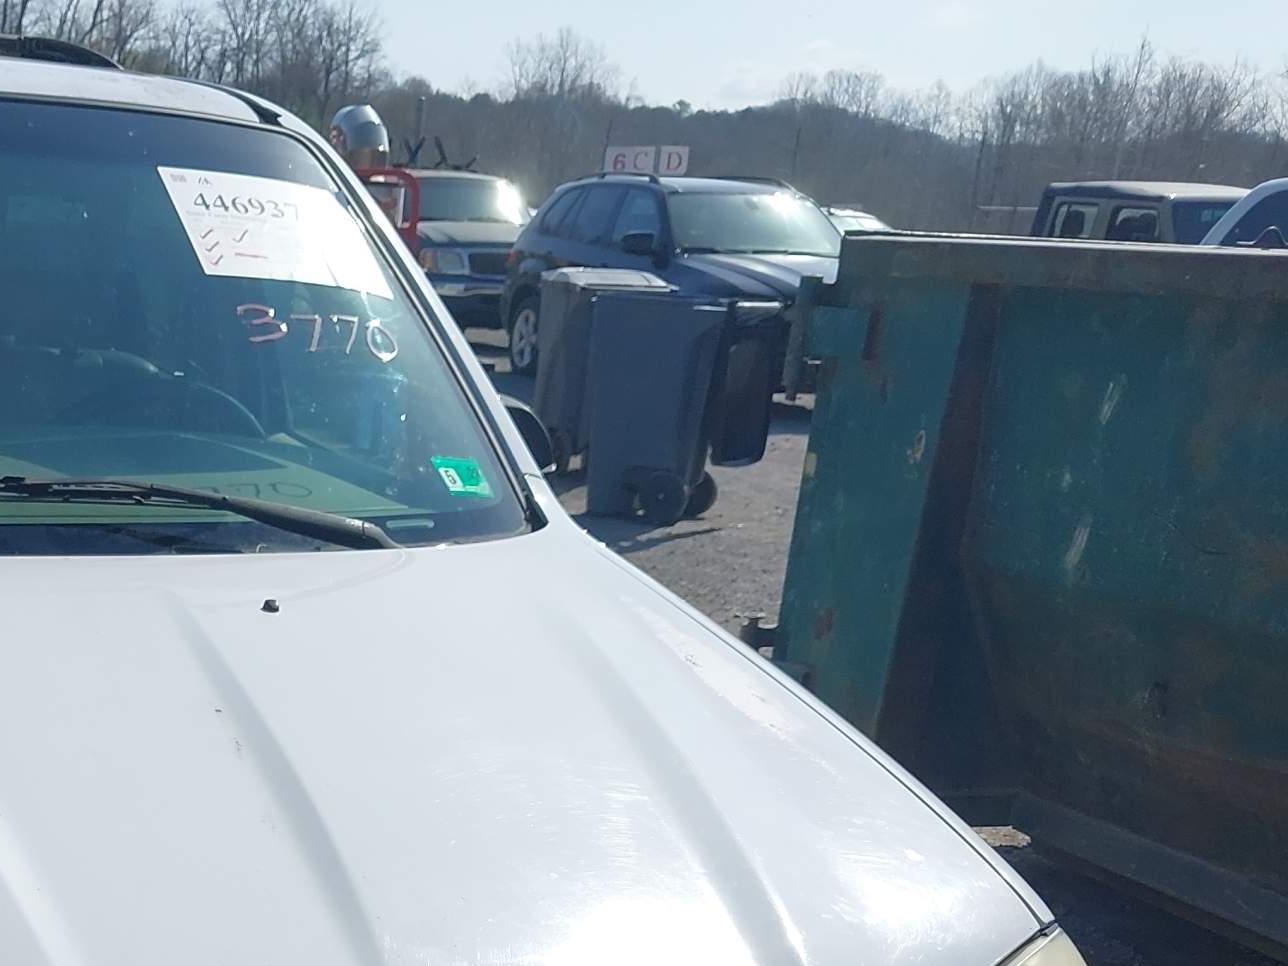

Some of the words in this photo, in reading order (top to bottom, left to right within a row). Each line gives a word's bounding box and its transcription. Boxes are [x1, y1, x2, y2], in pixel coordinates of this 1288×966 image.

[612, 152, 626, 172] 6
[633, 151, 649, 171] C
[665, 151, 683, 171] D
[236, 303, 399, 363] 3770
